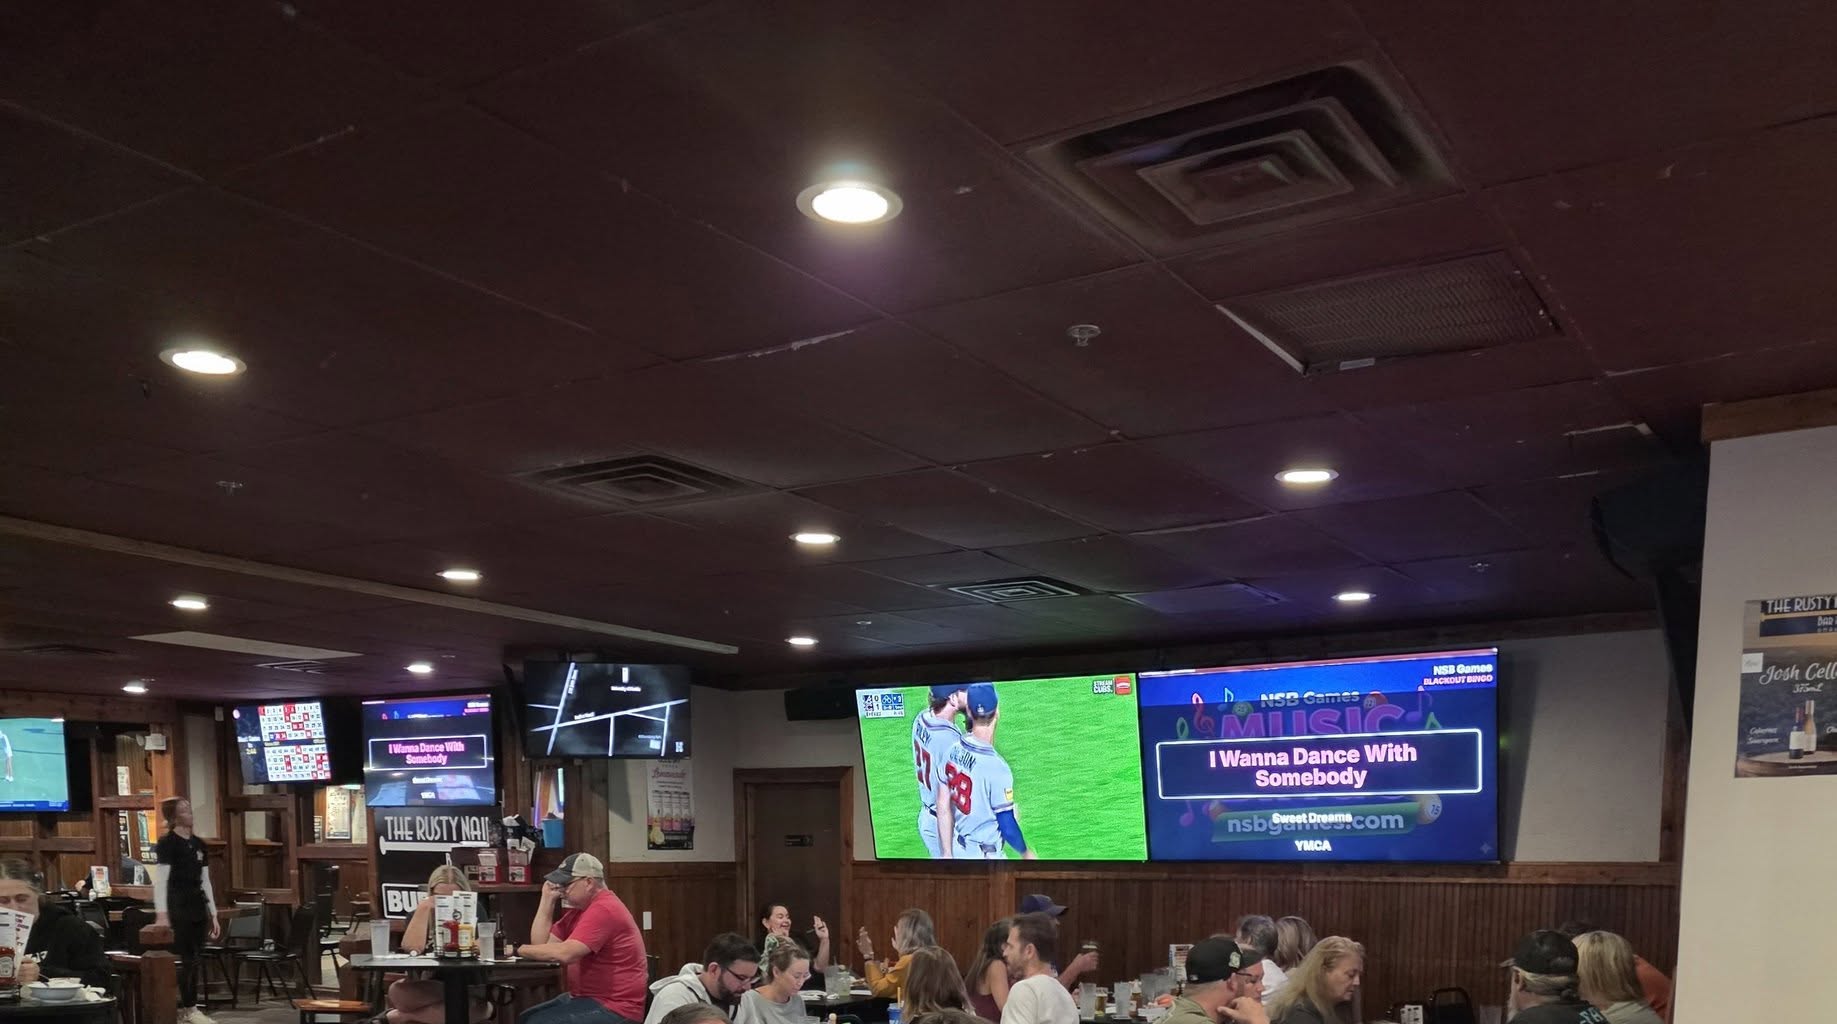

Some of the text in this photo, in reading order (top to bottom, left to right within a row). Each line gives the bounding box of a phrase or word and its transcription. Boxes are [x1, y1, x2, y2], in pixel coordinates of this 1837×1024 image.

[1766, 596, 1832, 613] THE RUSTY
[1817, 616, 1834, 626] BAR
[1433, 663, 1493, 675] NSB Games
[1759, 664, 1800, 685] Josh
[1805, 662, 1837, 680] Cell
[1423, 674, 1493, 686] BLACKOUT BINGO
[1260, 690, 1360, 708] NSB Games
[393, 743, 419, 753] Wanna
[420, 742, 445, 752] Dance
[445, 741, 465, 752] With
[406, 753, 448, 765] Somebody
[1209, 743, 1418, 768] I Wanna Dance With
[1255, 767, 1368, 788] Somebody
[1271, 812, 1353, 824] Sweet Dreams
[384, 816, 414, 840] THE
[416, 816, 458, 841] RUSTY
[1294, 840, 1332, 851] YMCA
